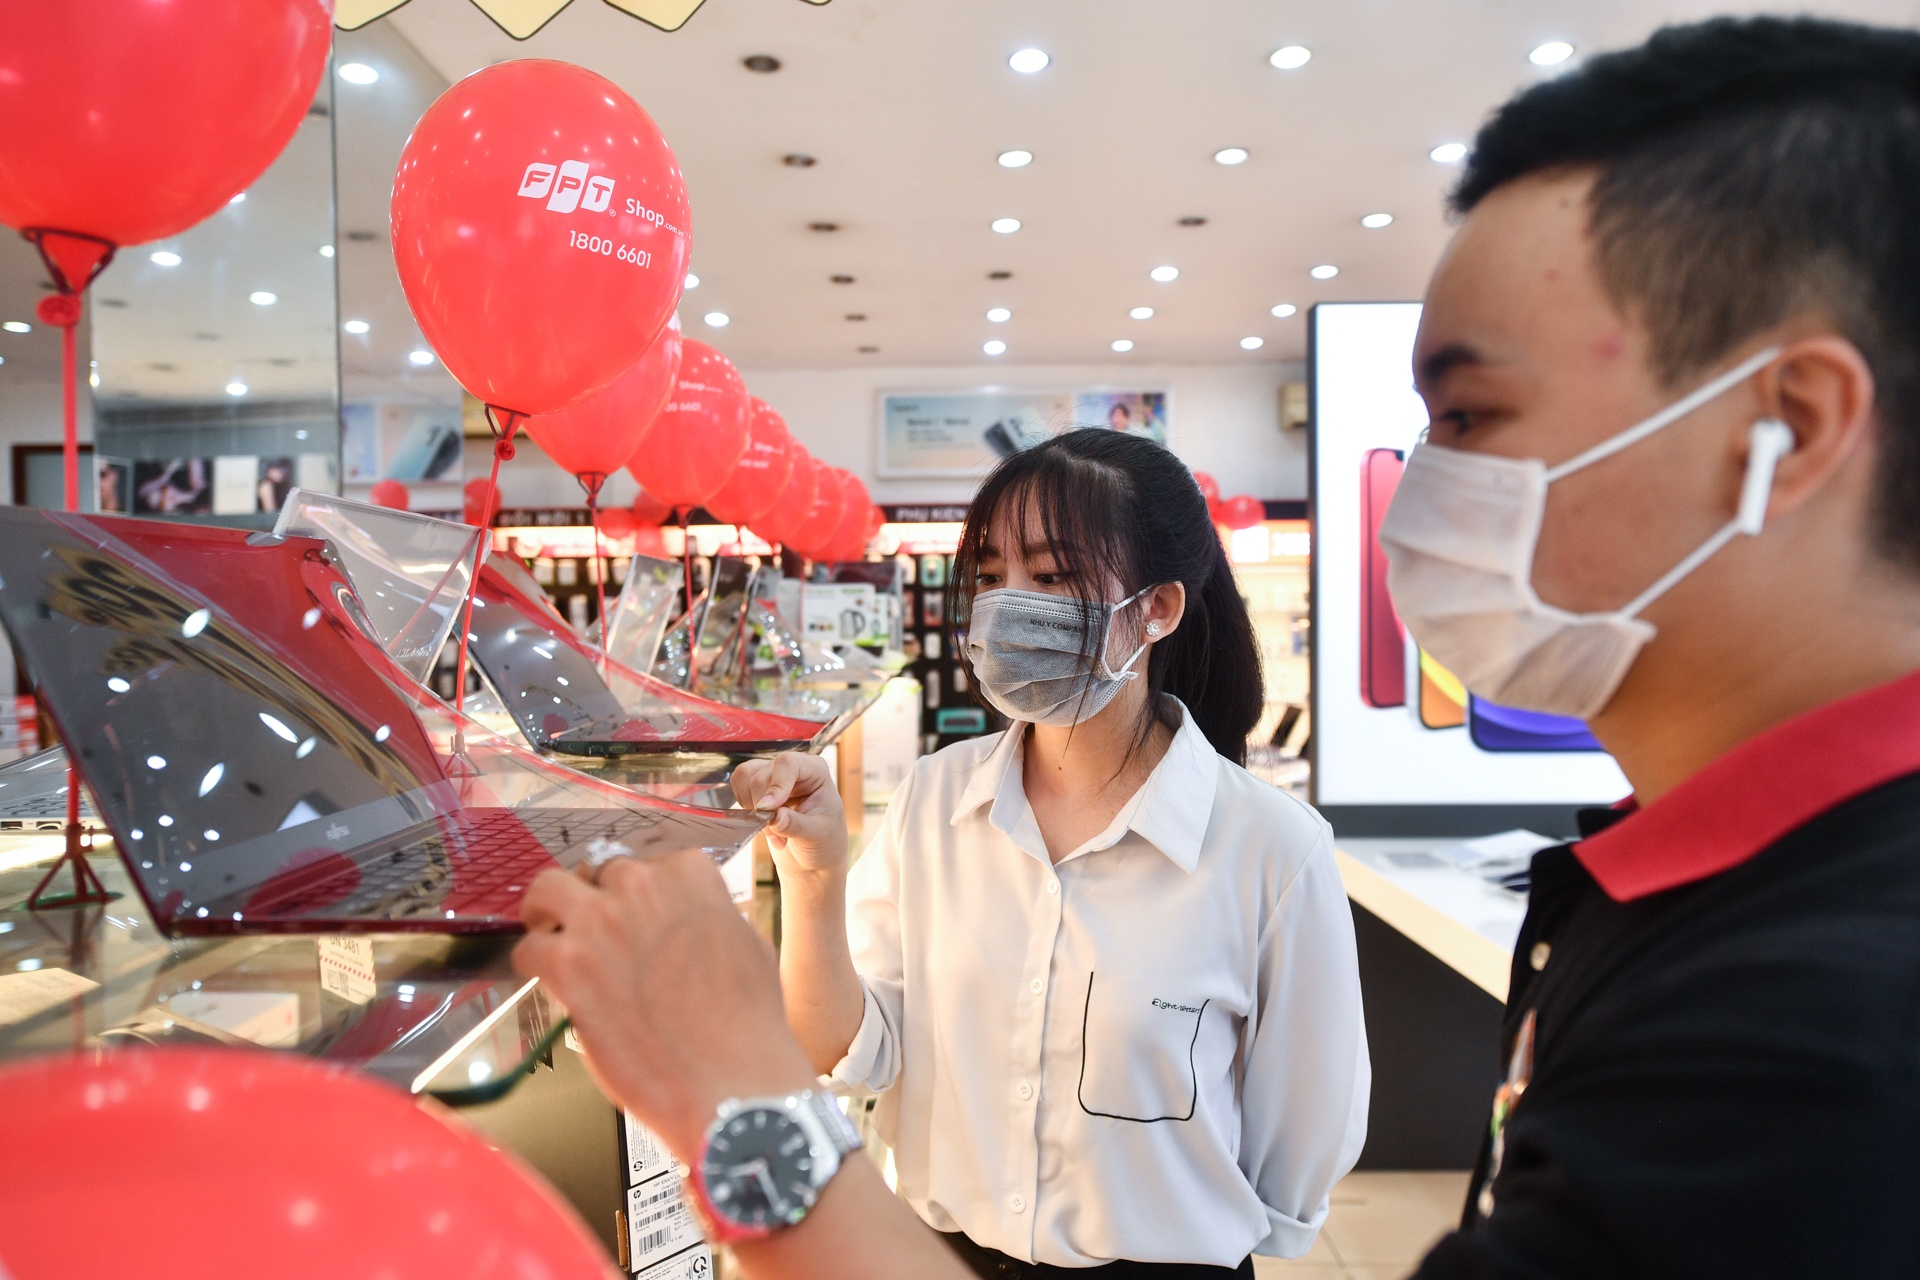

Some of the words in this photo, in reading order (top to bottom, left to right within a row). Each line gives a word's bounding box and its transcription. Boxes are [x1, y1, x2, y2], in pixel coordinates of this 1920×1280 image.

[518, 161, 615, 212] FPT
[569, 230, 613, 256] 1800
[616, 244, 652, 269] 6601
[343, 937, 360, 955] 3481
